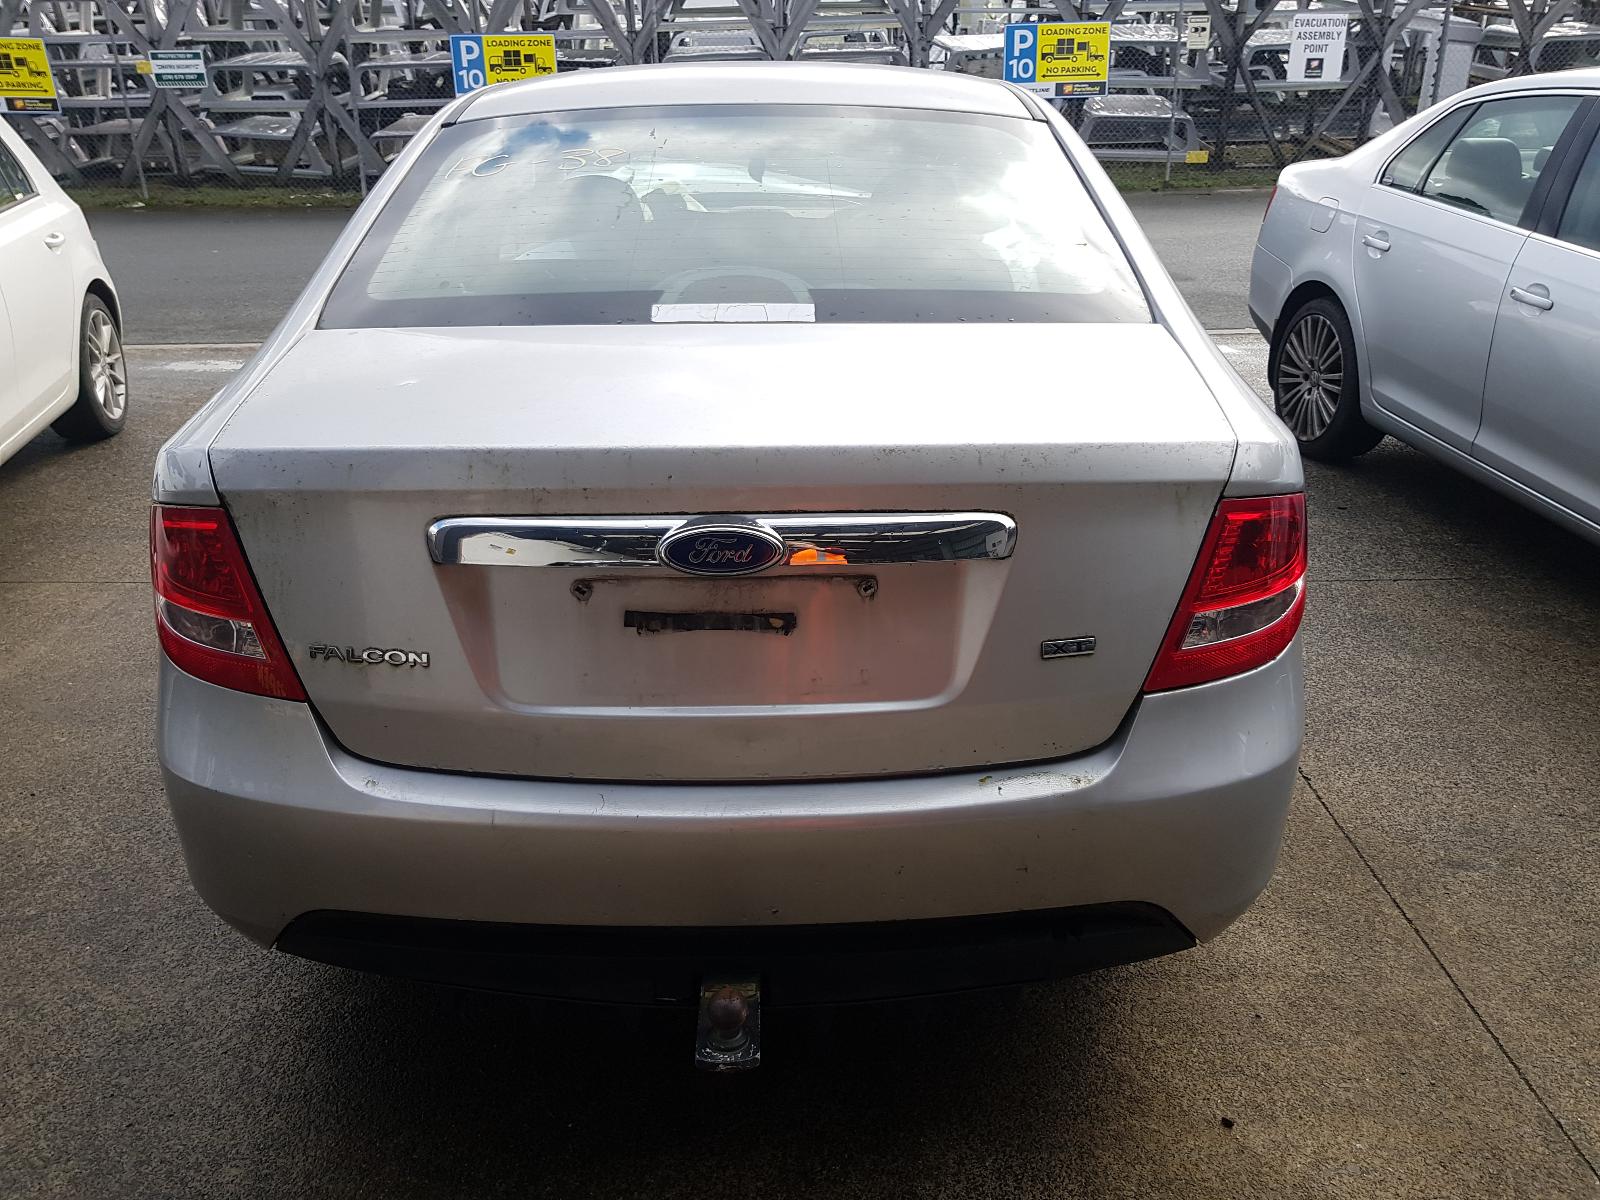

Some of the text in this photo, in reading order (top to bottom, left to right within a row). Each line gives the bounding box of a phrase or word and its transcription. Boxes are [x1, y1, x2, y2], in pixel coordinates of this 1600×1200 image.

[1294, 18, 1347, 28] EVACUATION
[1041, 27, 1108, 36] LOADING ZONE
[1296, 31, 1342, 41] ASSEMBLY
[486, 39, 552, 47] LOADING ZONE
[1013, 29, 1034, 57] P
[1303, 44, 1329, 53] POINT
[459, 40, 480, 68] P
[1008, 58, 1034, 79] 10
[6, 81, 43, 89] PARKING
[458, 69, 485, 89] 10
[689, 537, 753, 564] Ford
[308, 644, 431, 668] FALCON
